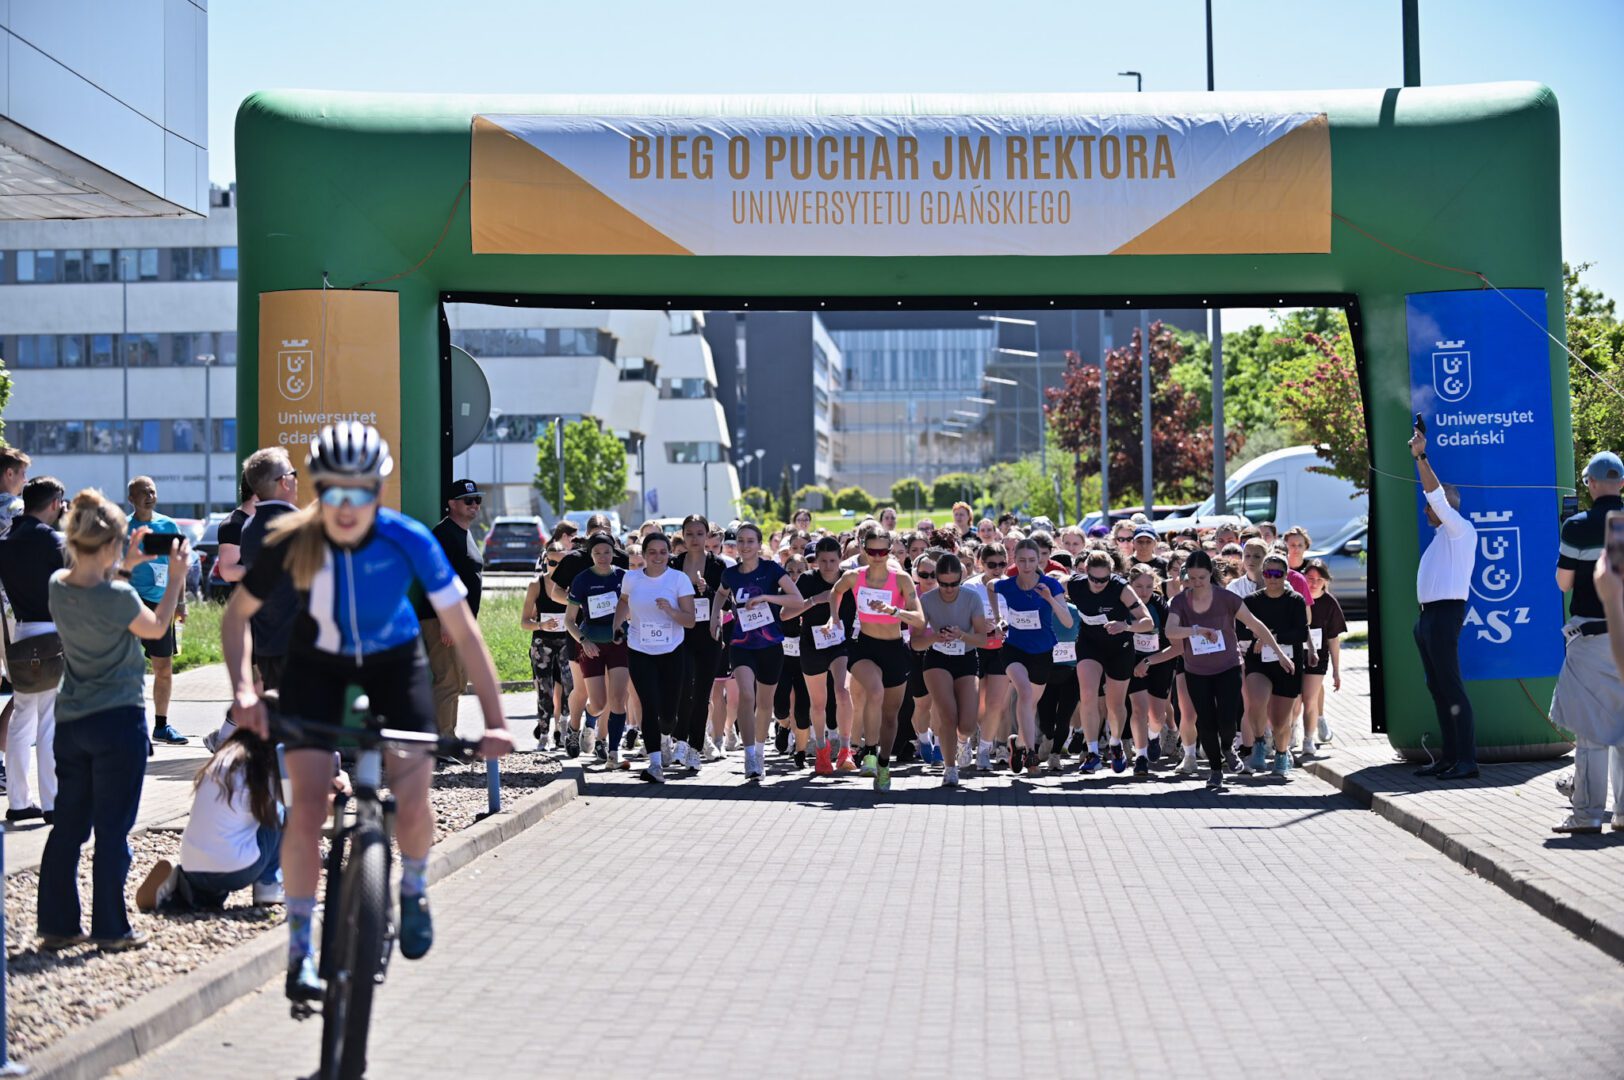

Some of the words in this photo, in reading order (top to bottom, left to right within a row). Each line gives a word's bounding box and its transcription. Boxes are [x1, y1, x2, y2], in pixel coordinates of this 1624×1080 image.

[629, 135, 714, 181] BIEG
[728, 135, 751, 181] O
[765, 135, 919, 181] PUCHAR
[932, 135, 991, 181] JM
[1006, 134, 1176, 180] REKTORA
[732, 190, 911, 225] UNIWERSYTETU
[920, 185, 1071, 225] GDAŃSKIEGO
[1436, 410, 1535, 427] Uniwersytet
[278, 429, 321, 445] Gdań
[1436, 430, 1505, 447] Gdański
[747, 611, 763, 622] 284
[650, 629, 662, 637] 50
